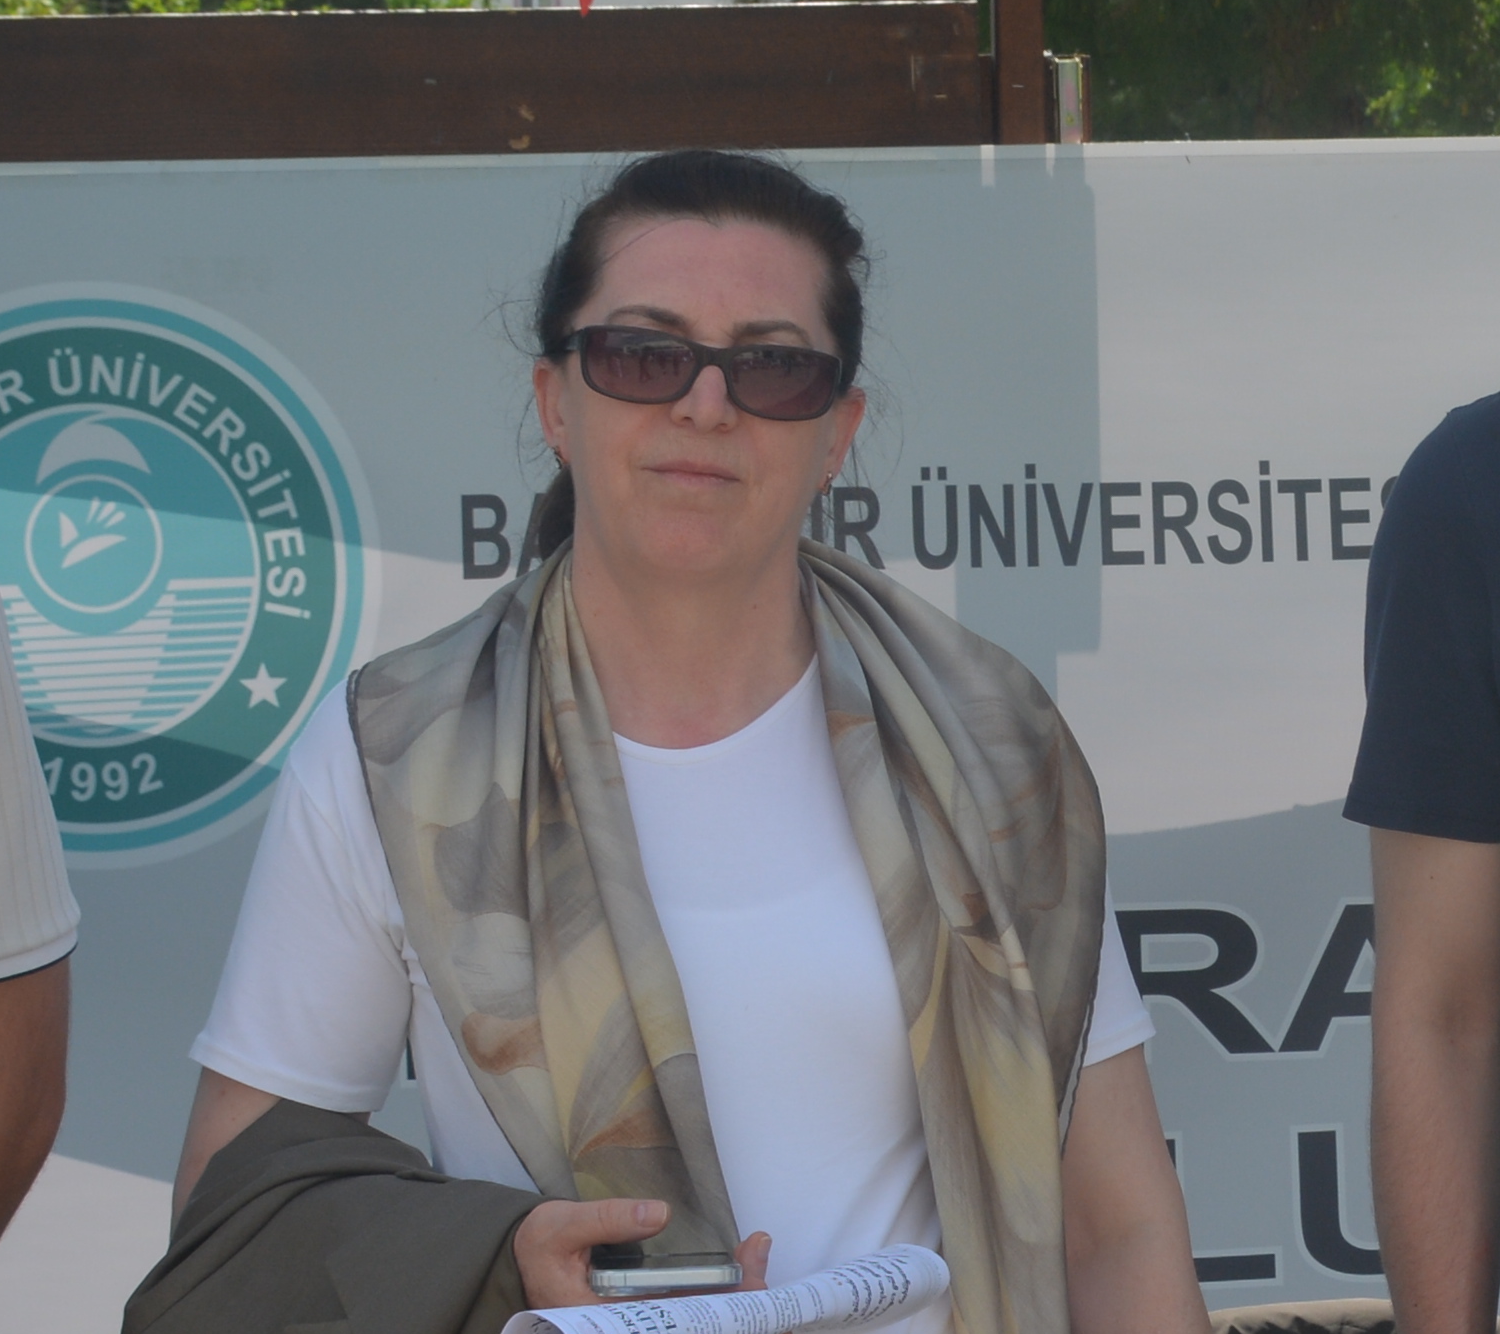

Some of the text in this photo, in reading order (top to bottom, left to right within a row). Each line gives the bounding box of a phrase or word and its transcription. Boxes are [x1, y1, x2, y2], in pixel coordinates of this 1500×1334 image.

[47, 348, 311, 621] ÜNİVERSİTESİ
[911, 460, 1400, 571] ÜNİVERSİTE
[43, 752, 164, 802] 1992
